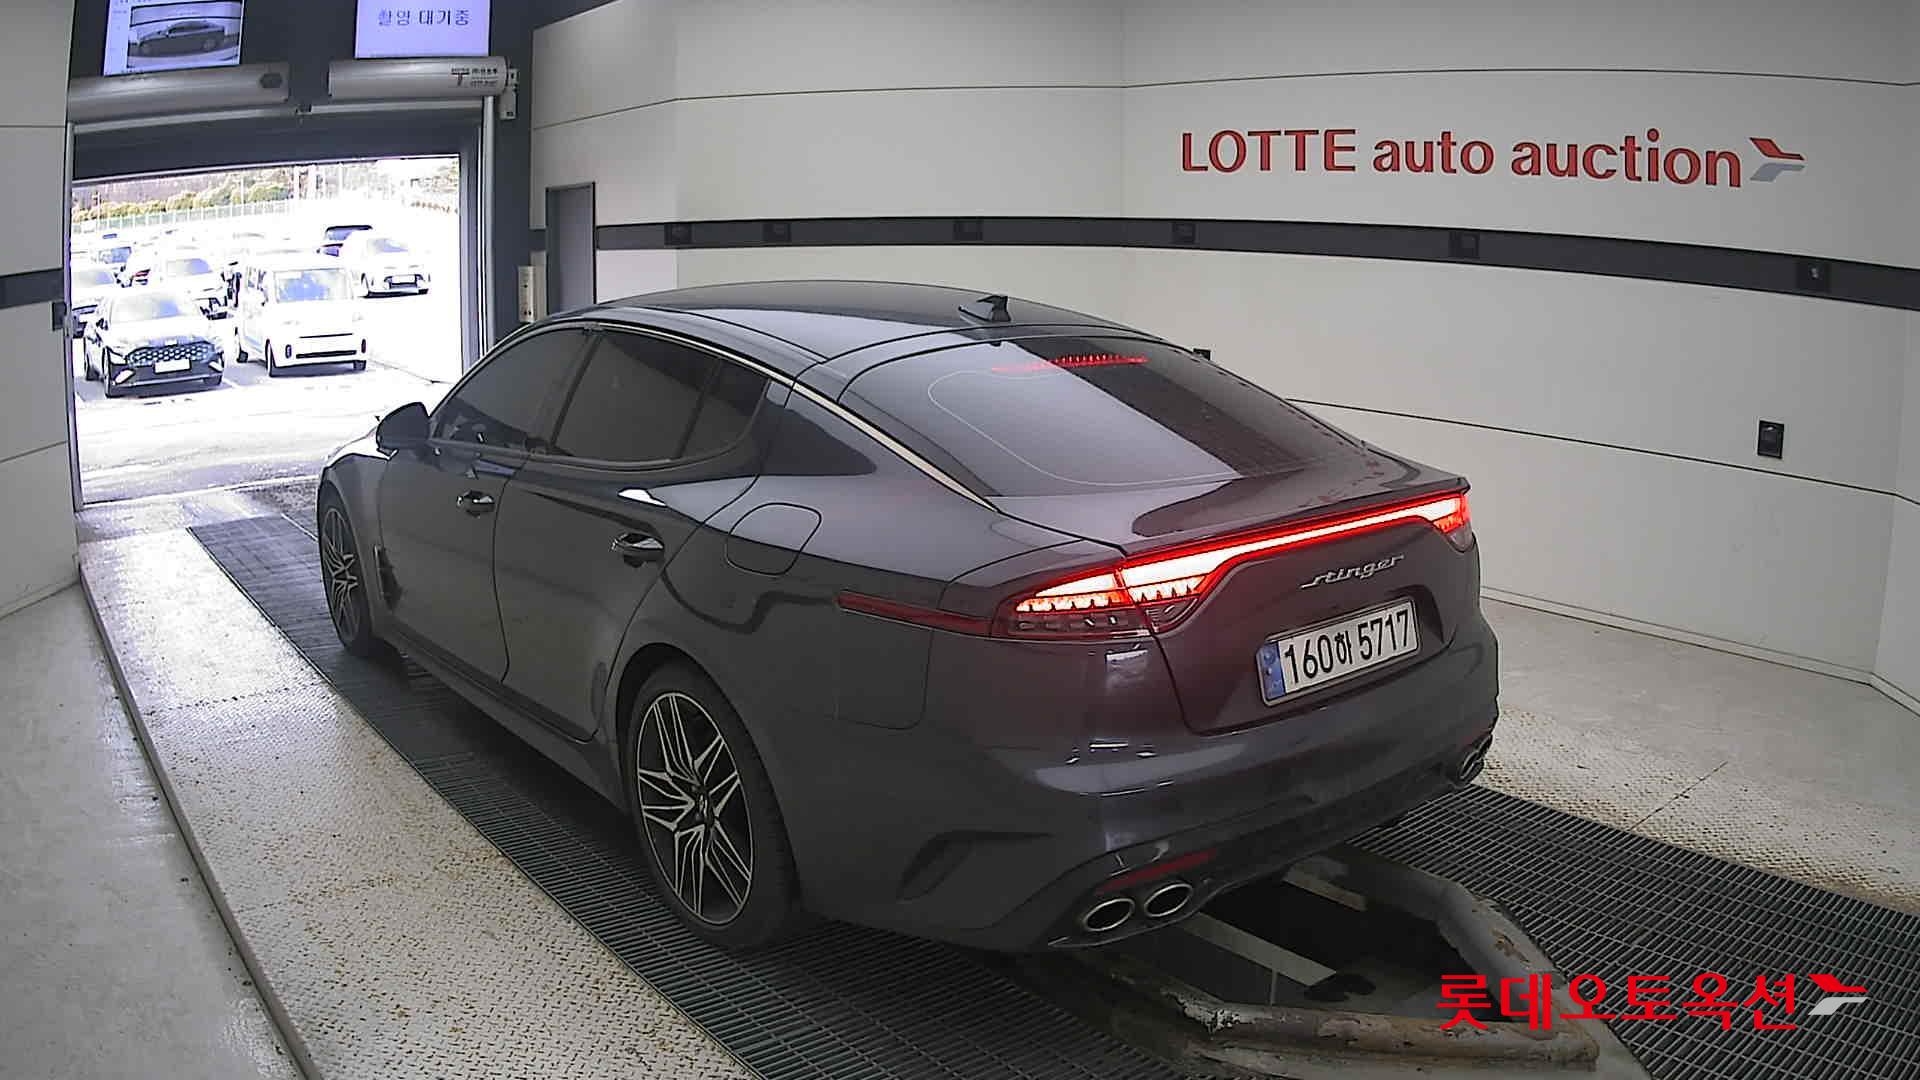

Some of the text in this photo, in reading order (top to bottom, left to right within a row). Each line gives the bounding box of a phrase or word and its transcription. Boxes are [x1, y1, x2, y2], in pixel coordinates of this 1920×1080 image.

[419, 9, 469, 26] 대기중
[1182, 128, 1741, 187] LOTTE auto auction
[1284, 609, 1409, 684] 160하 5717
